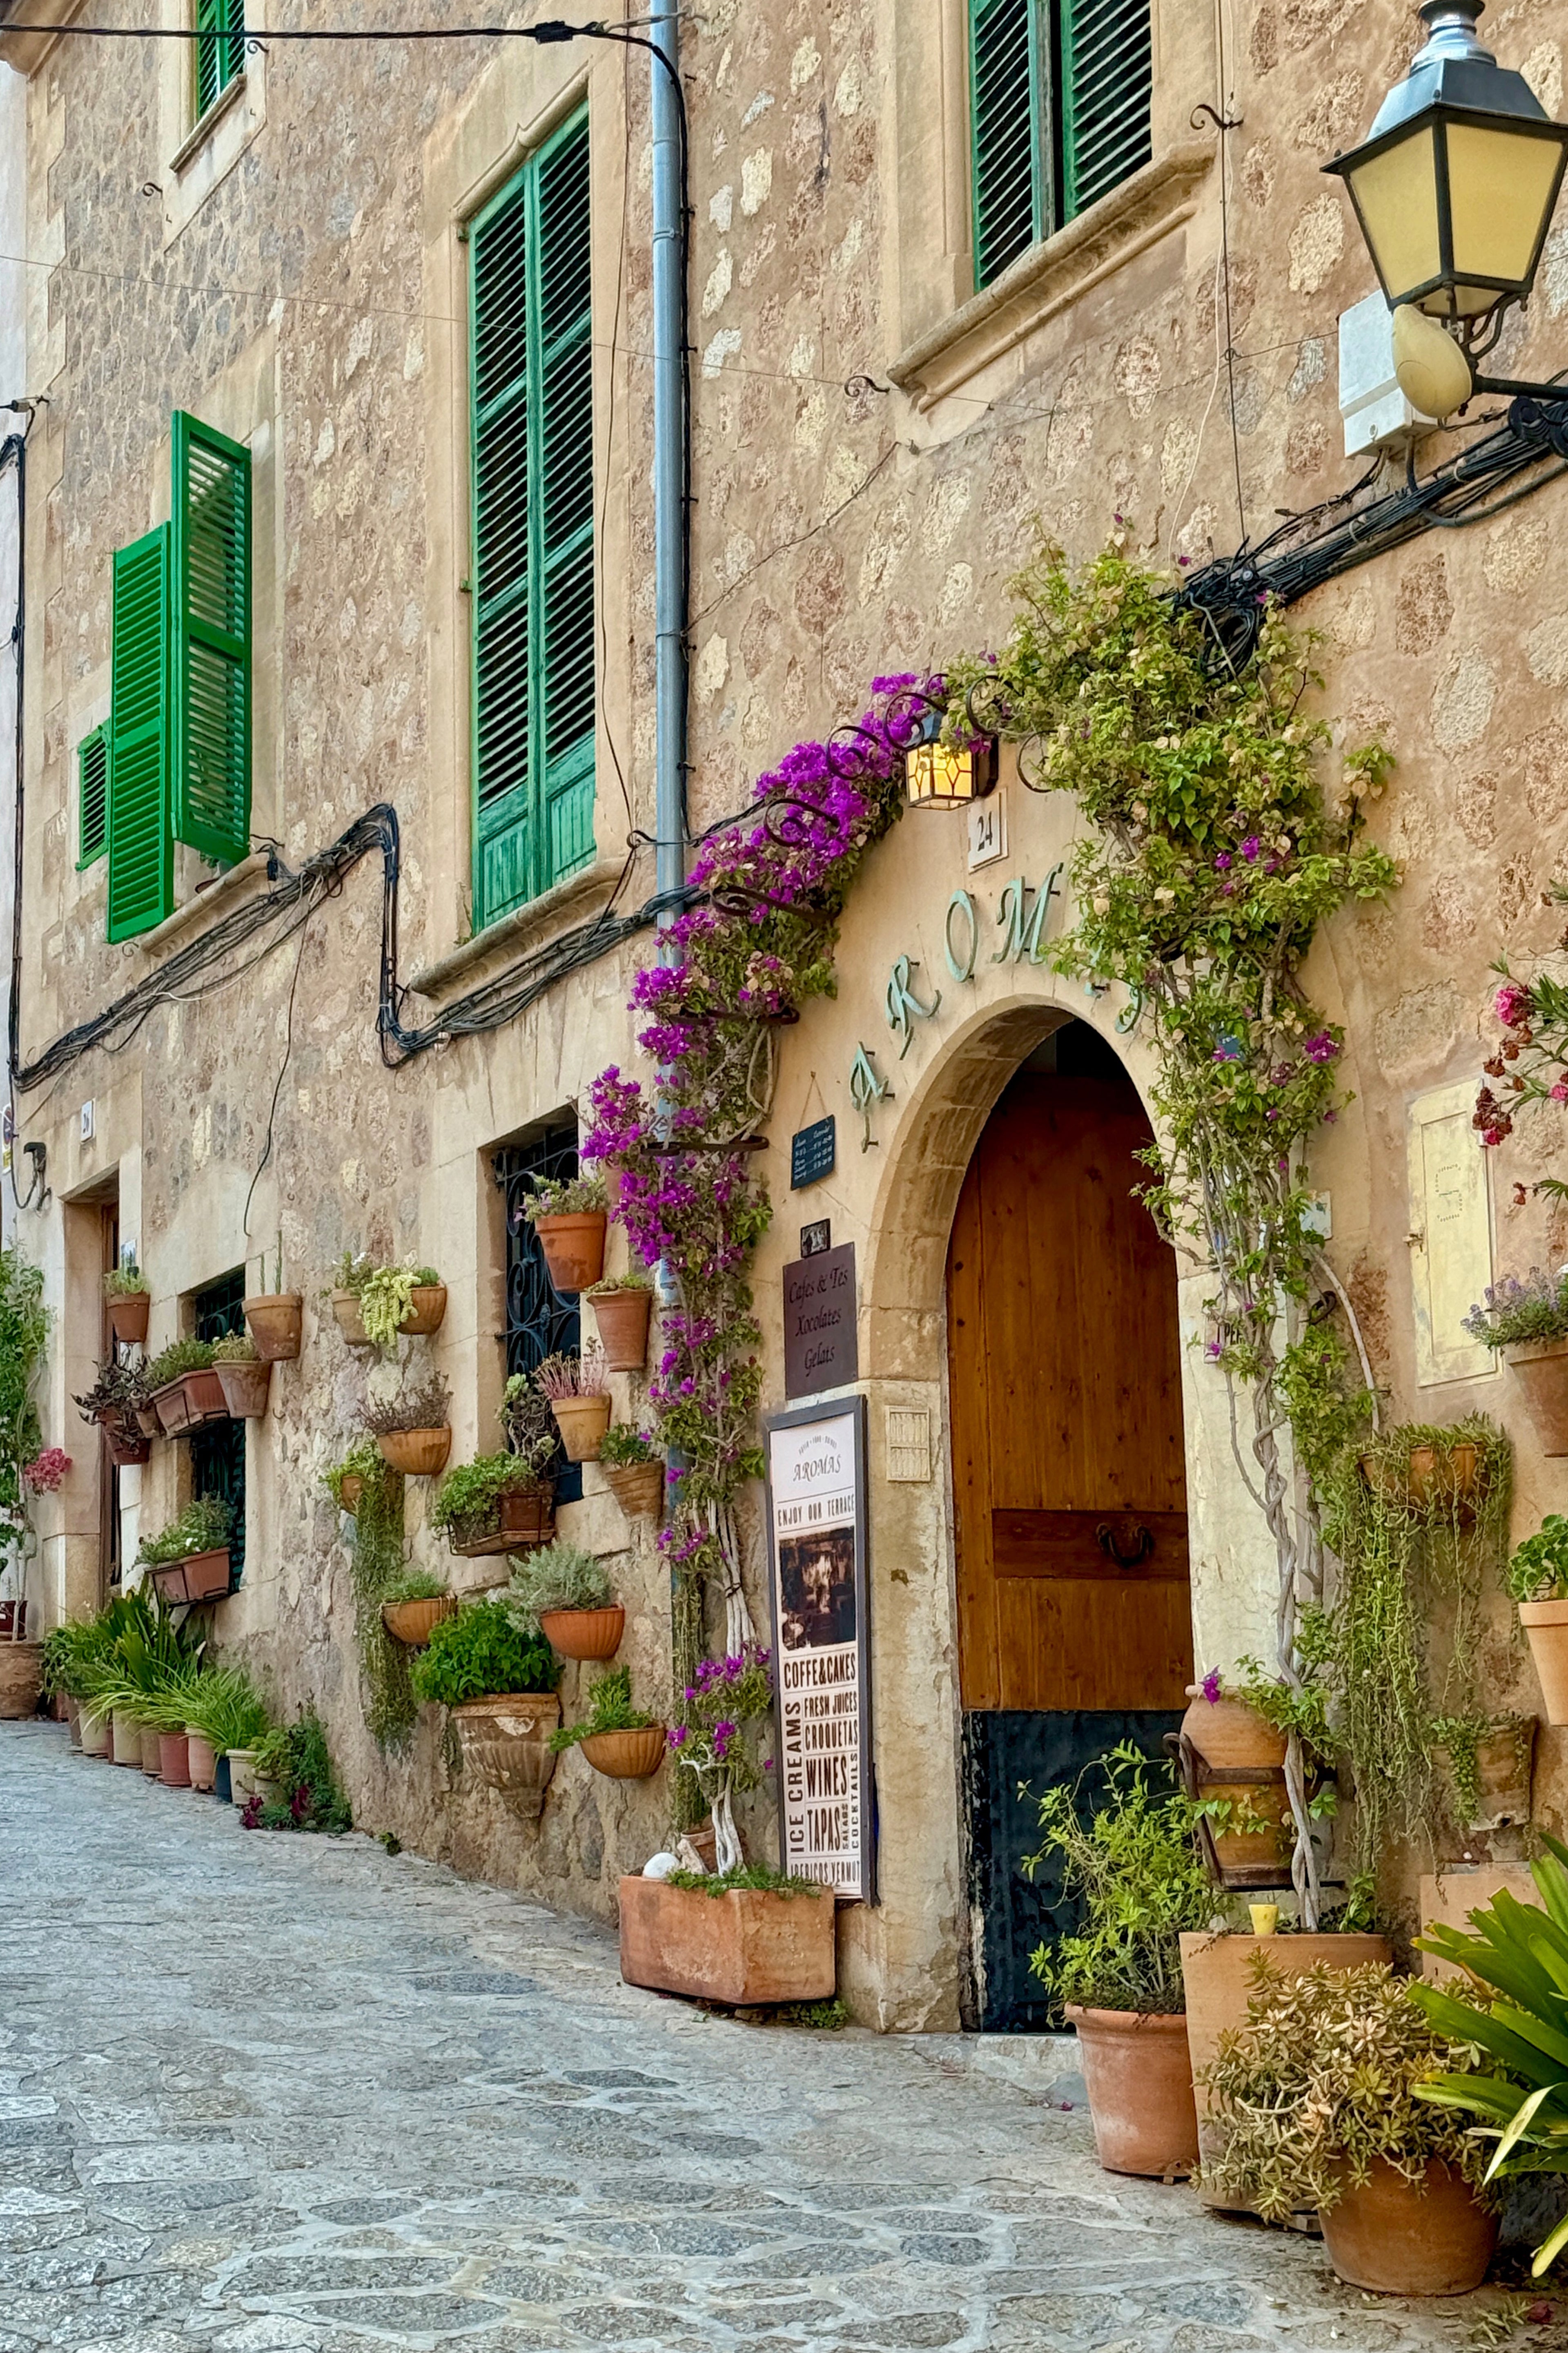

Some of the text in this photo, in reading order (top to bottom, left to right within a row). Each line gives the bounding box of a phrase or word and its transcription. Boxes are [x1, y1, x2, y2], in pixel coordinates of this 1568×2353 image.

[977, 811, 993, 852] 24
[795, 1306, 842, 1337] Xocolates
[804, 1342, 835, 1378] Gelats
[793, 1454, 842, 1482] AROMAS
[778, 1494, 854, 1527] ENJOY OUR TERRACE
[804, 1691, 857, 1717] FRESH JUICES
[805, 1720, 858, 1751] CROQUETAS
[785, 1702, 804, 1852] ICE CREAMS
[806, 1755, 847, 1798] WINES
[851, 1753, 859, 1849] COCKTAILS
[807, 1807, 840, 1852] TAPAS
[831, 1860, 860, 1882] VERMUT
